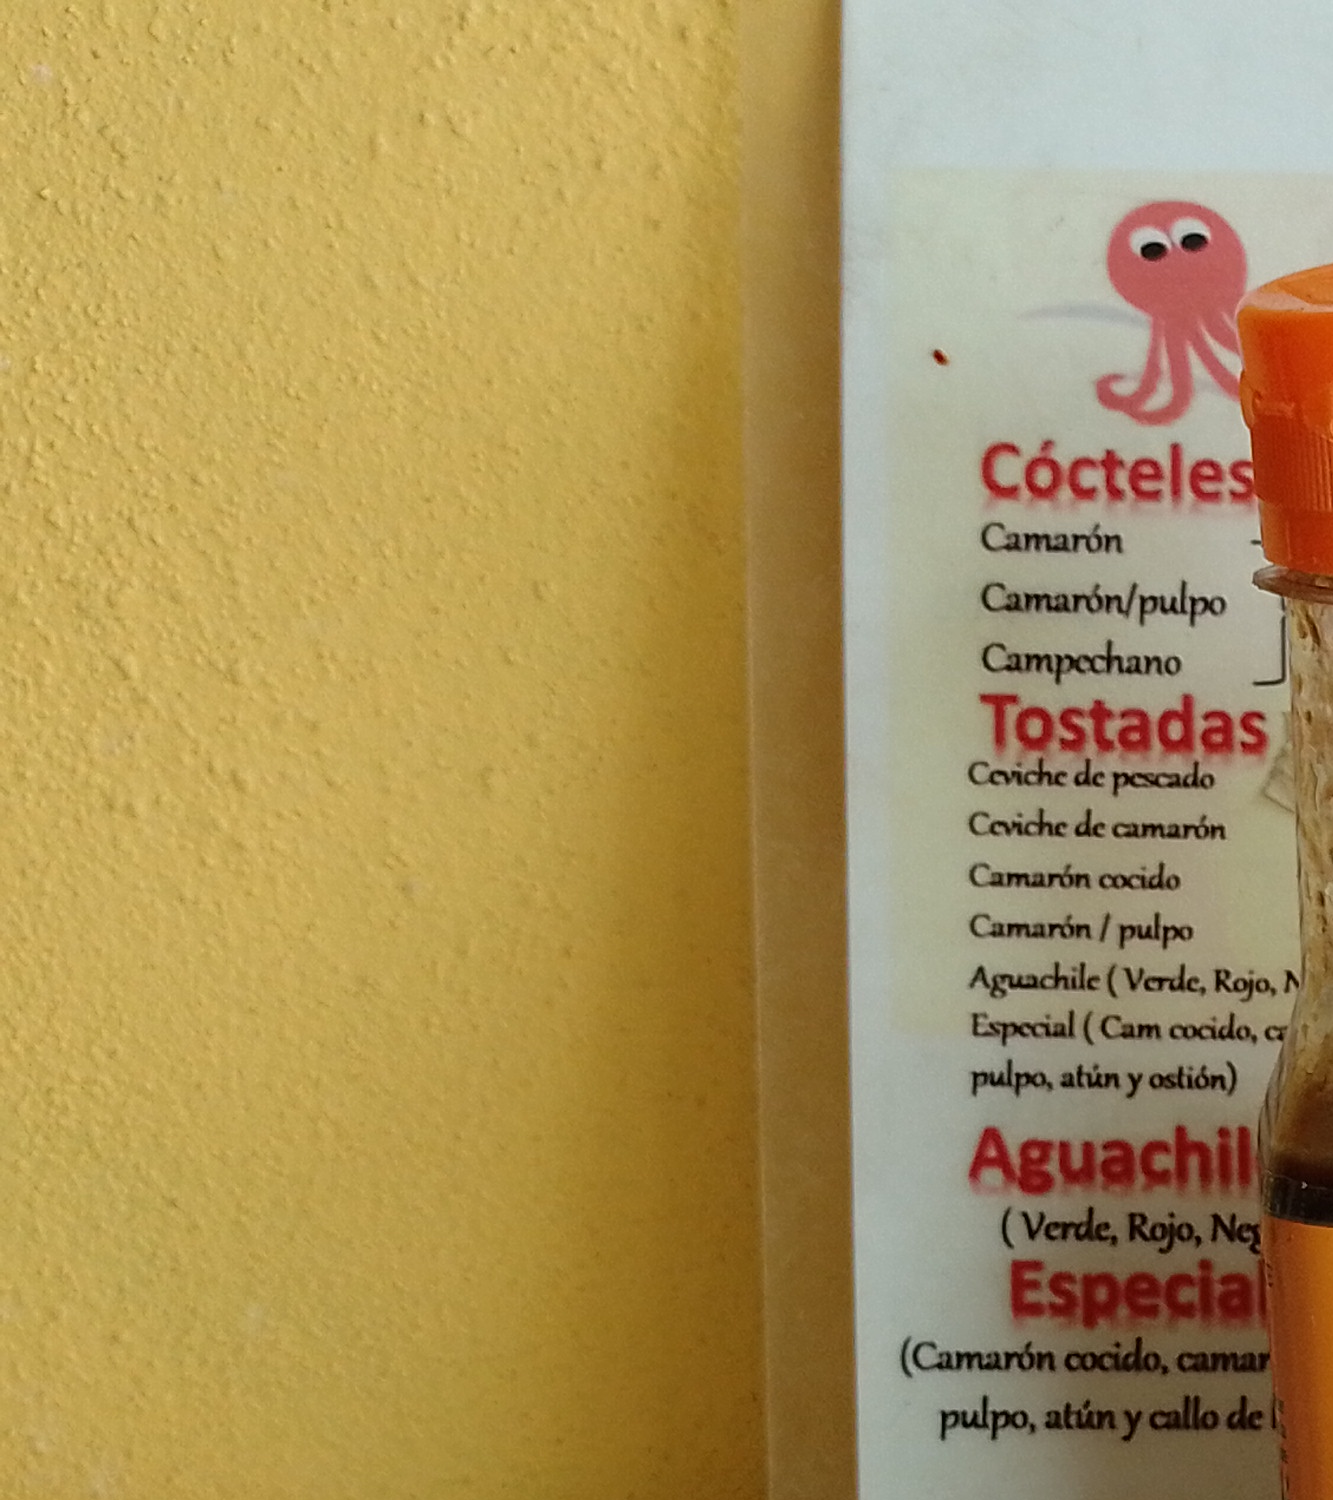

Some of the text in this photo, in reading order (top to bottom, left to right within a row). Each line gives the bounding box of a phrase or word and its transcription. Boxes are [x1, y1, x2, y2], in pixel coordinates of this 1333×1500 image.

[979, 439, 1254, 502] Cócteles
[981, 523, 1123, 554] Camarón
[981, 582, 1228, 620] Camarón/pulpo
[981, 644, 1182, 684] Campechano
[979, 693, 1269, 755] Tostadas
[968, 760, 1215, 795] Ceviche de pescado
[968, 811, 1226, 841] Ceviche de camarón
[968, 863, 1181, 891] Camarón cocido
[968, 913, 1194, 949] Camarón / pulpo
[968, 963, 1101, 999] Aguachile
[1124, 967, 1207, 997] Verde,
[1214, 968, 1278, 1002] Rojo,
[971, 1010, 1075, 1046] Especial
[1100, 1015, 1161, 1041] Cam
[1169, 1014, 1258, 1046] cocido,
[971, 1059, 1237, 1098] pulpo, atún y ostión)
[968, 1126, 1259, 1195] Aguachil
[1024, 1209, 1118, 1247] Verde,
[1128, 1213, 1202, 1253] Rojo,
[901, 1337, 1055, 1378] (Camarón
[1064, 1337, 1169, 1375] cocido,
[940, 1395, 1036, 1440] pulpo,
[1045, 1401, 1116, 1431] atún
[1123, 1408, 1144, 1441] y
[1149, 1395, 1217, 1431] callo
[1226, 1395, 1264, 1431] de
